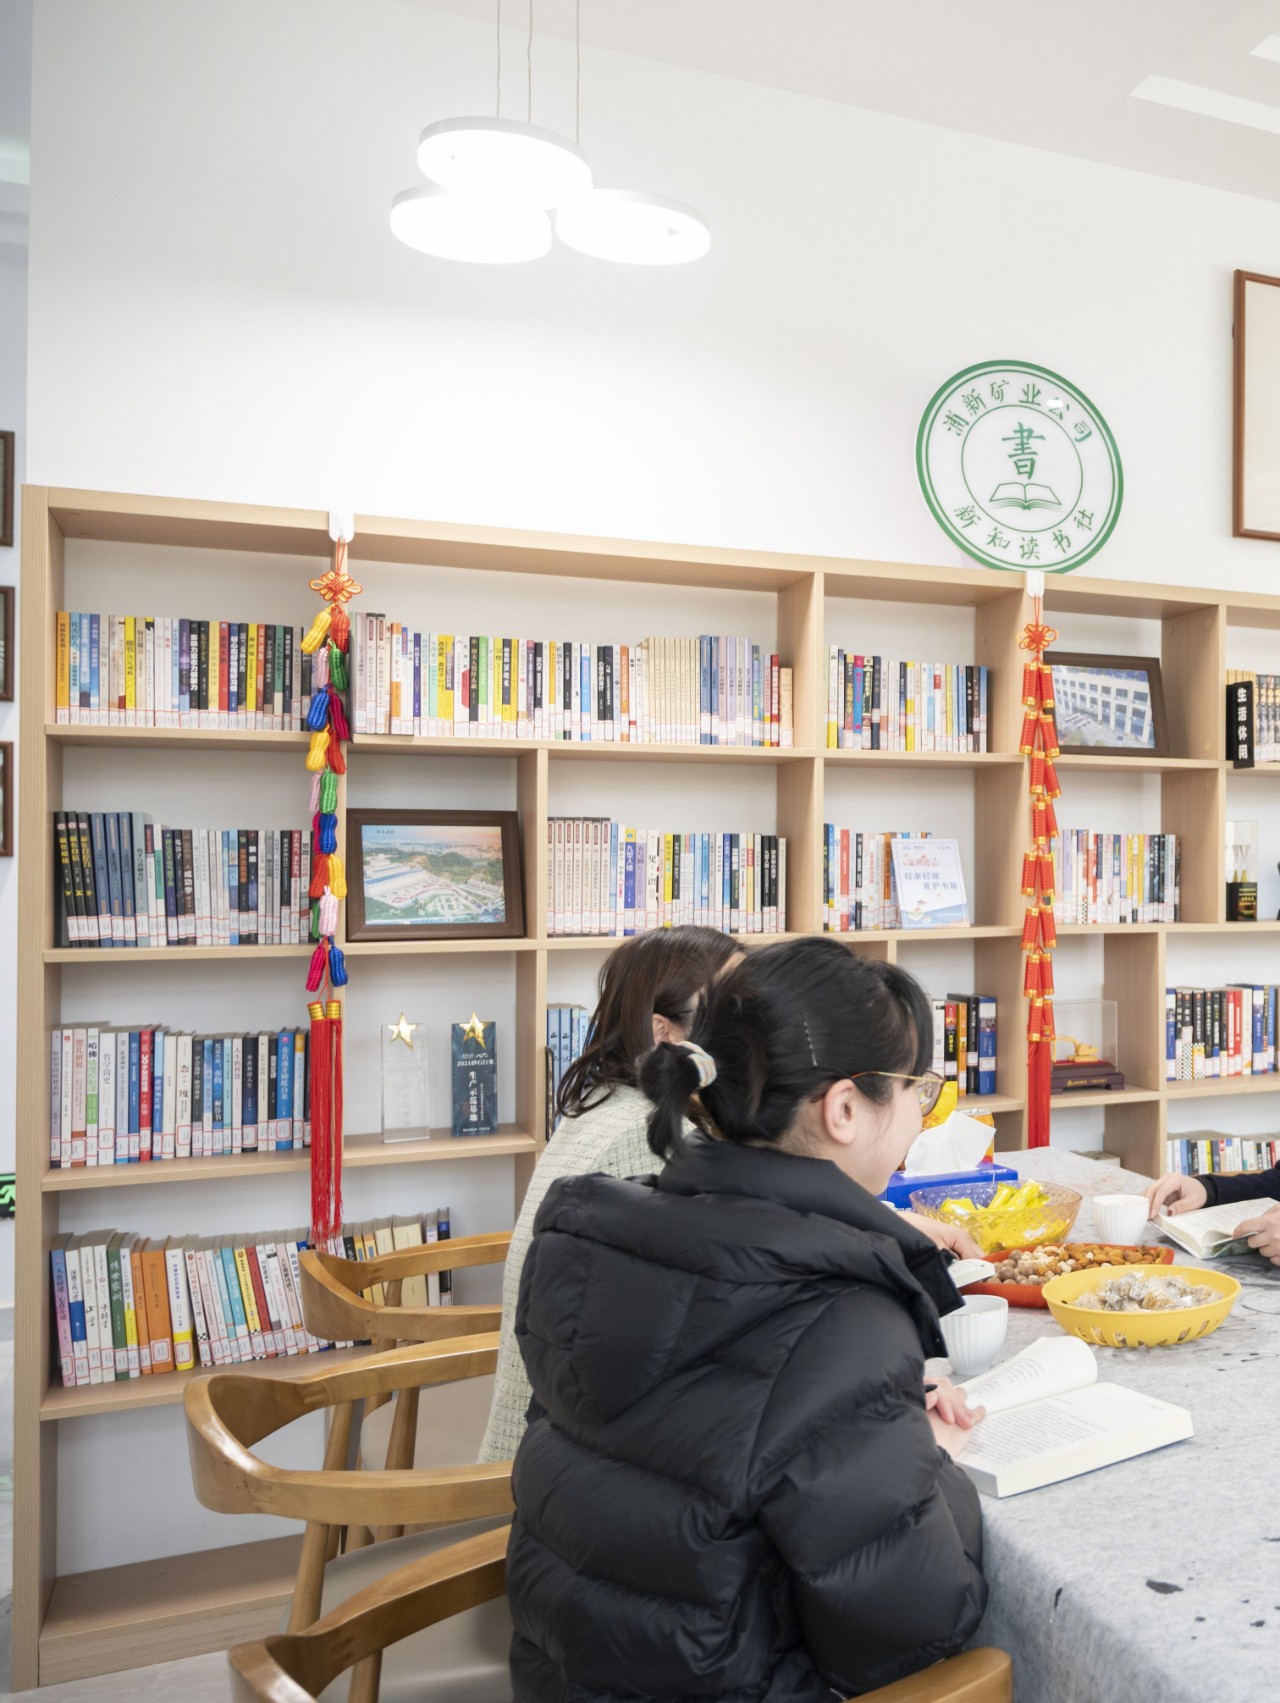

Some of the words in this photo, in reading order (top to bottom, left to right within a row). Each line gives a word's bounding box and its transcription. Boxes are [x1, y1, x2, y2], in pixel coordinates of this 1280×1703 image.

[954, 503, 1095, 562] 新知读书社
[626, 845, 634, 872] 九型人格
[905, 872, 939, 880] 轻拿轻放
[468, 1071, 478, 1122] 生产示范基地
[110, 1260, 122, 1301] 传世家训
